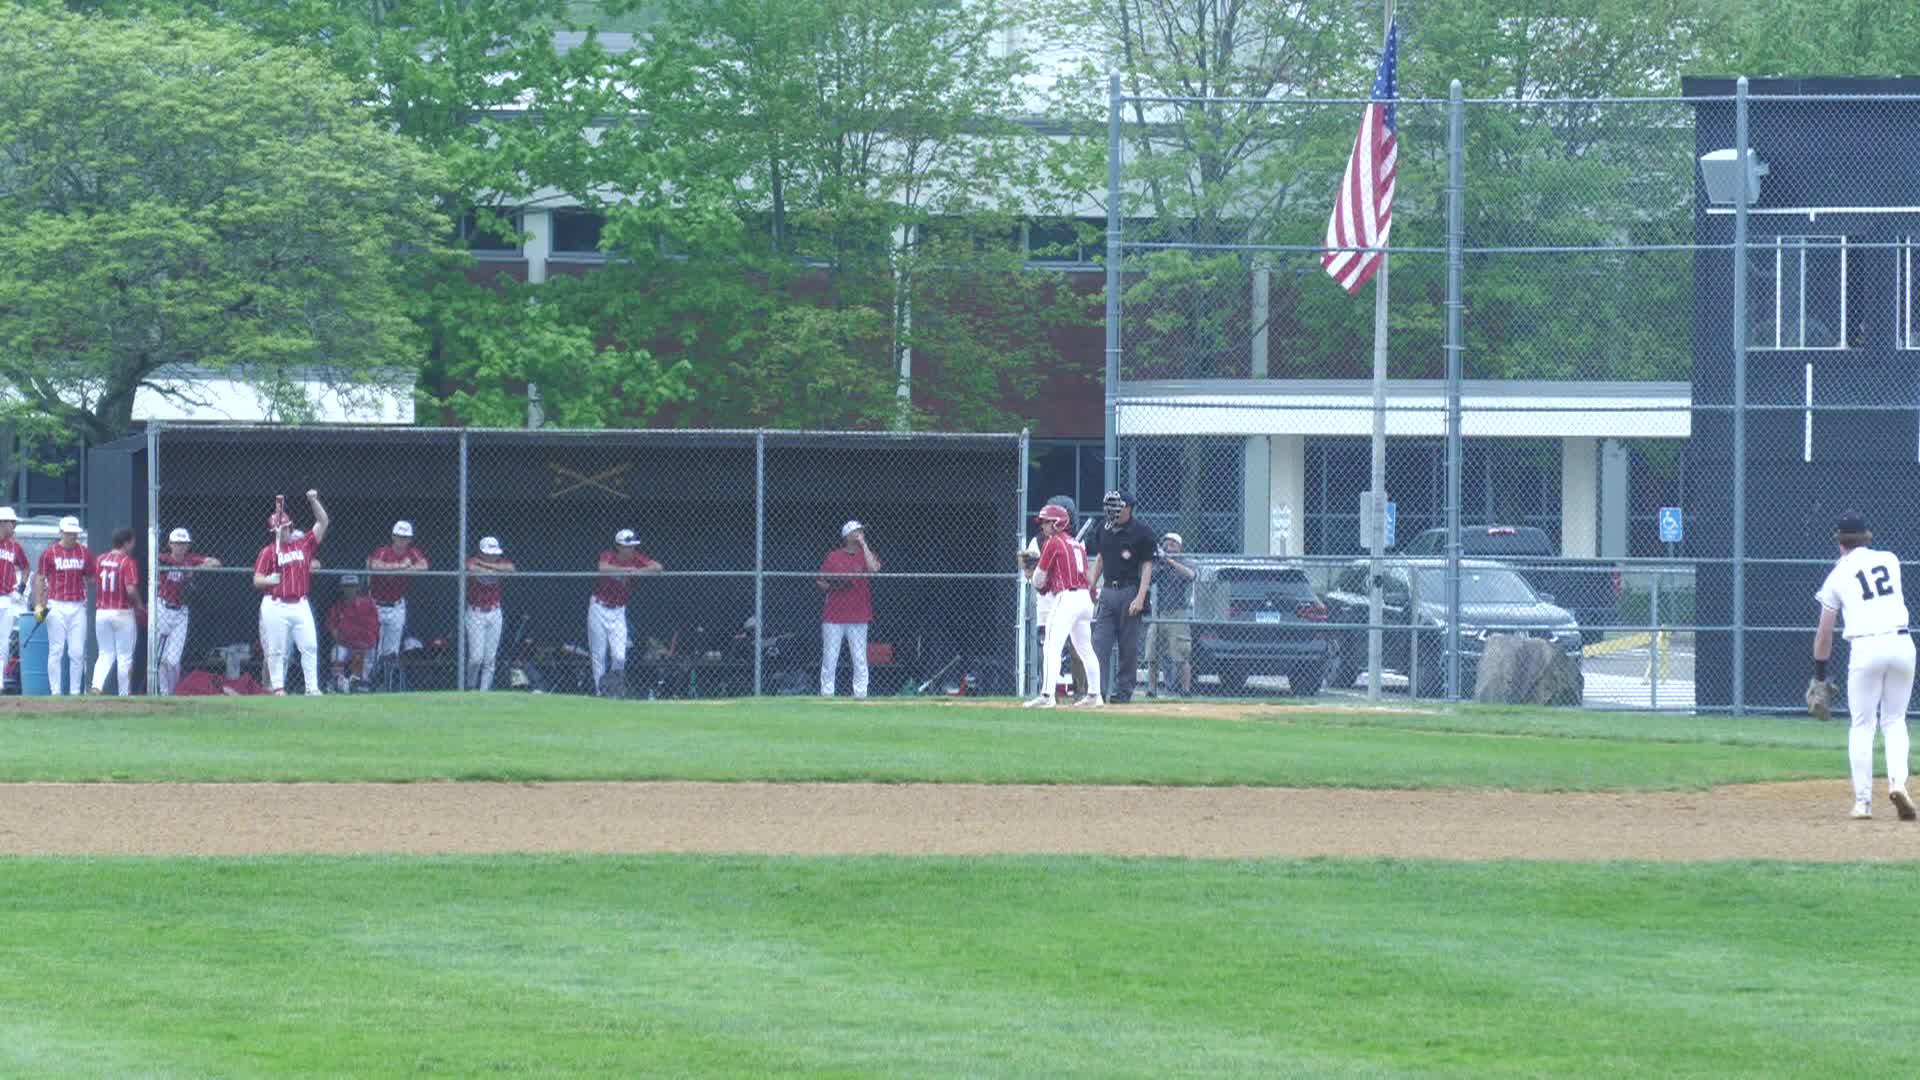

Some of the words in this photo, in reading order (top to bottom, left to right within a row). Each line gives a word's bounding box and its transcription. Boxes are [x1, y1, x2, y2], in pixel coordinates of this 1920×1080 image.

[55, 557, 84, 570] Rams
[100, 570, 115, 592] 11
[1855, 565, 1894, 600] 12
